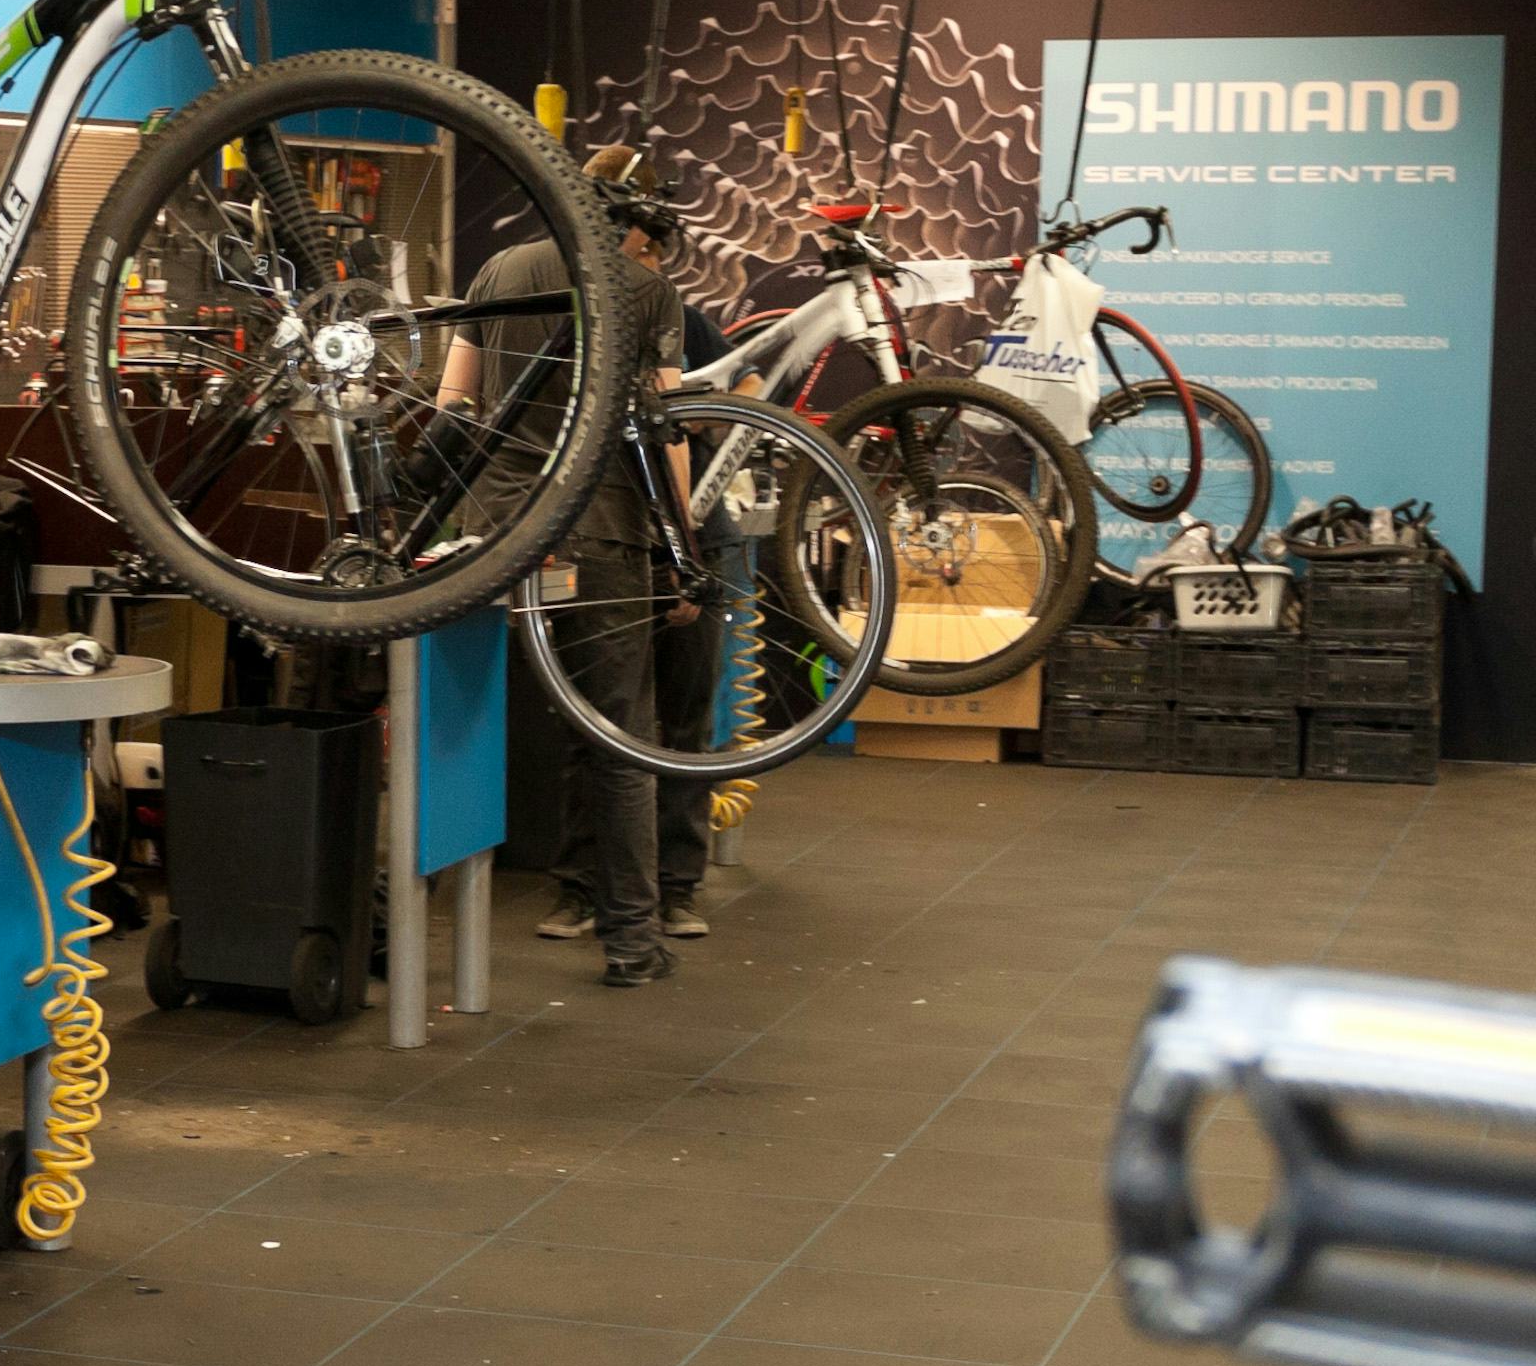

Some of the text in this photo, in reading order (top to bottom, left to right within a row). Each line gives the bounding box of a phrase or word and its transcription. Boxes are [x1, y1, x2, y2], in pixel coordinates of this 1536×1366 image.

[1085, 80, 1460, 134] SHIMANO
[1083, 166, 1457, 183] SERVICE CENTER
[1099, 521, 1157, 540] WAYS
